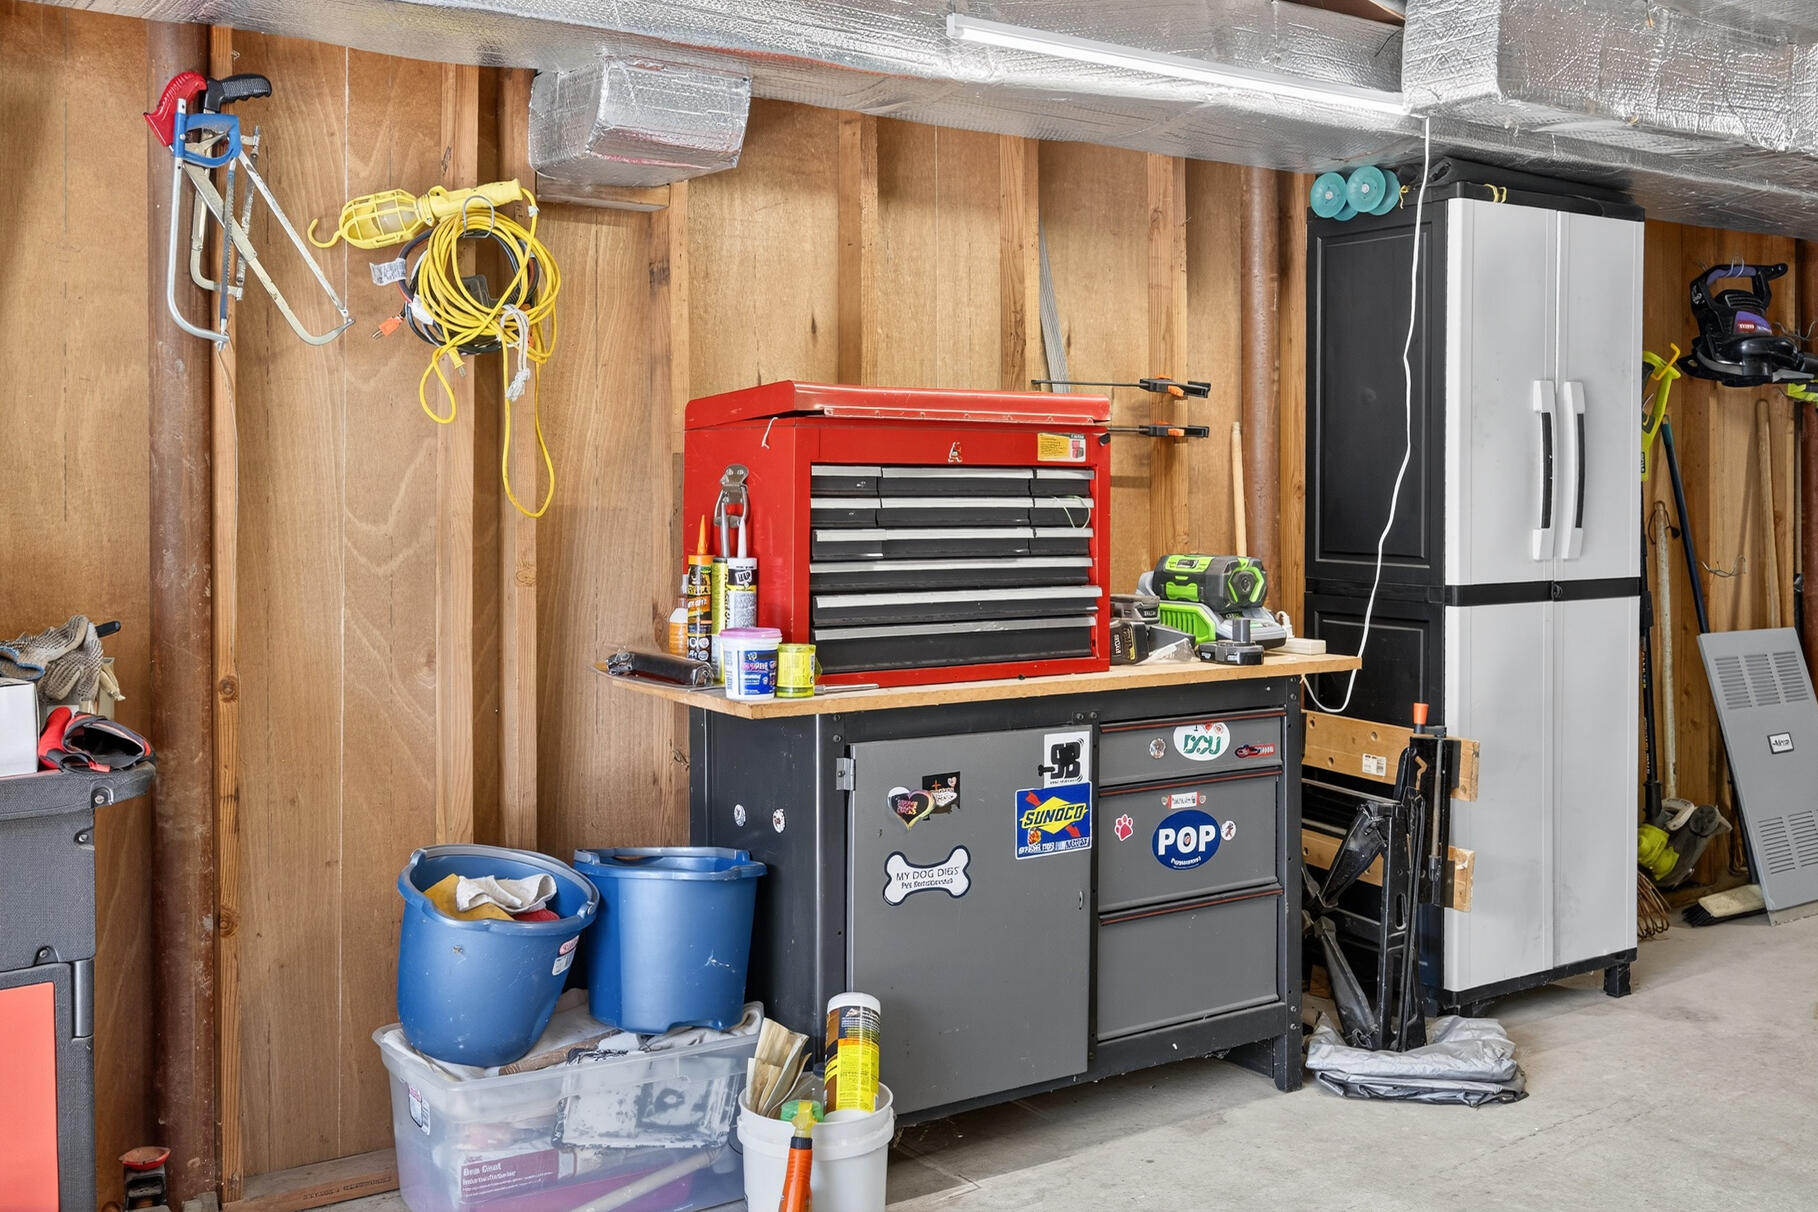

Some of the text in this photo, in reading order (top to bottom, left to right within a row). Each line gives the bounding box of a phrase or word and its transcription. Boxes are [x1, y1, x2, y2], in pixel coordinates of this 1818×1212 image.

[1023, 805, 1084, 827] SUNOCO
[1157, 824, 1216, 856] POP
[896, 866, 960, 881] MY DOG DIGS
